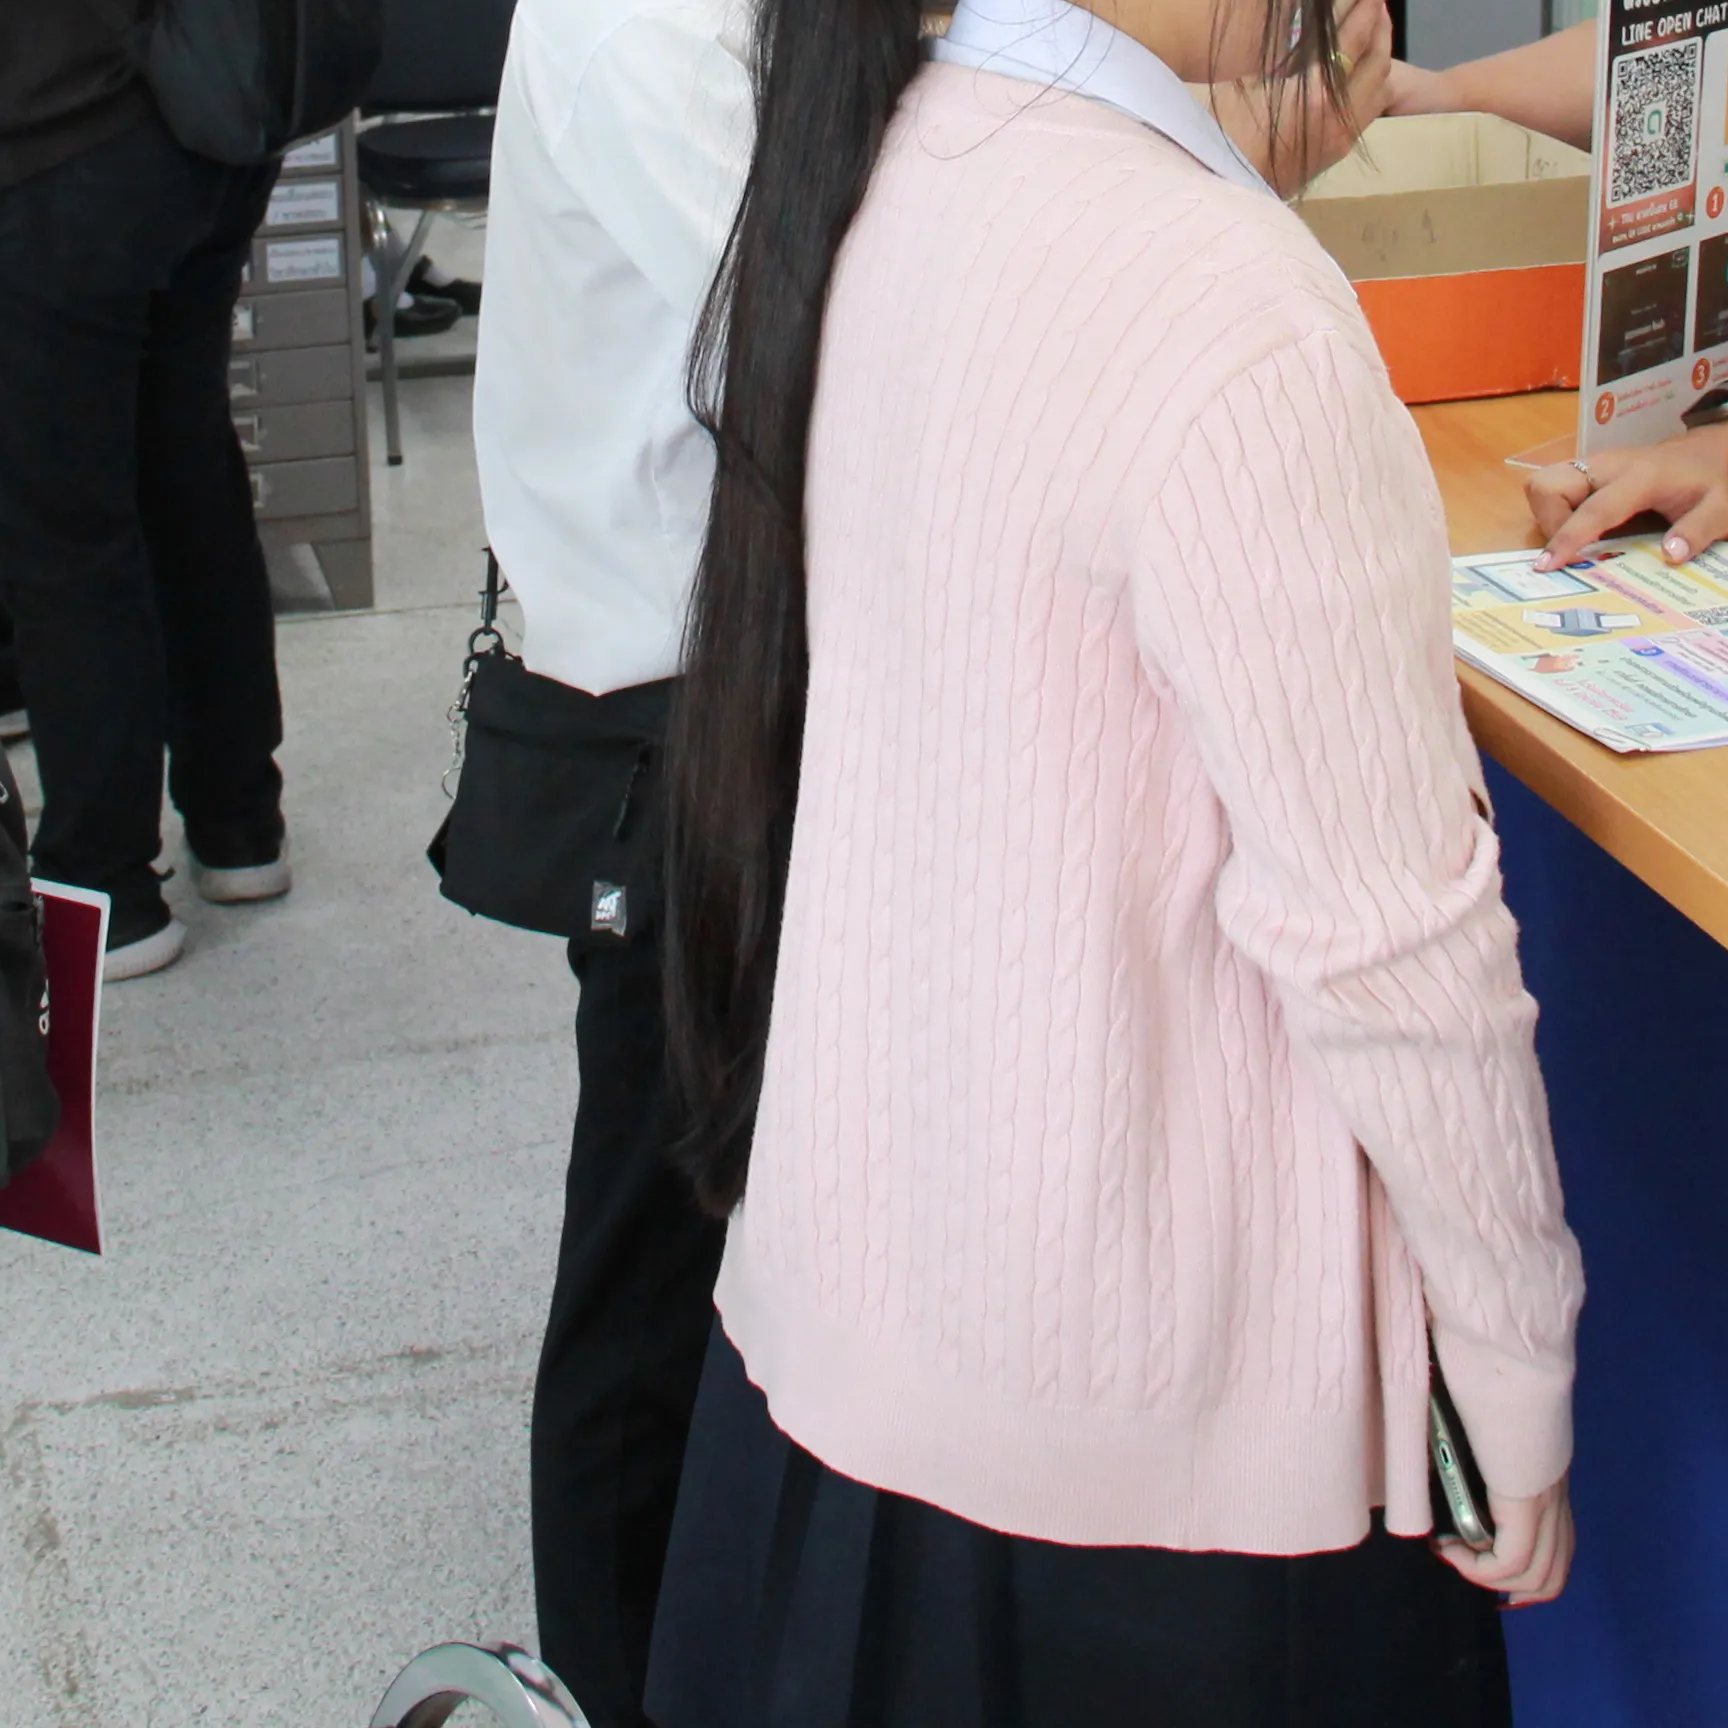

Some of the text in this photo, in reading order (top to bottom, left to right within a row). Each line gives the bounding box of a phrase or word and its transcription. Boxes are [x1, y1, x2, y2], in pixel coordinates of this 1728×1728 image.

[1622, 2, 1728, 46] LINE OPEN CHAT
[1697, 366, 1705, 385] 3
[1600, 399, 1610, 419] 2
